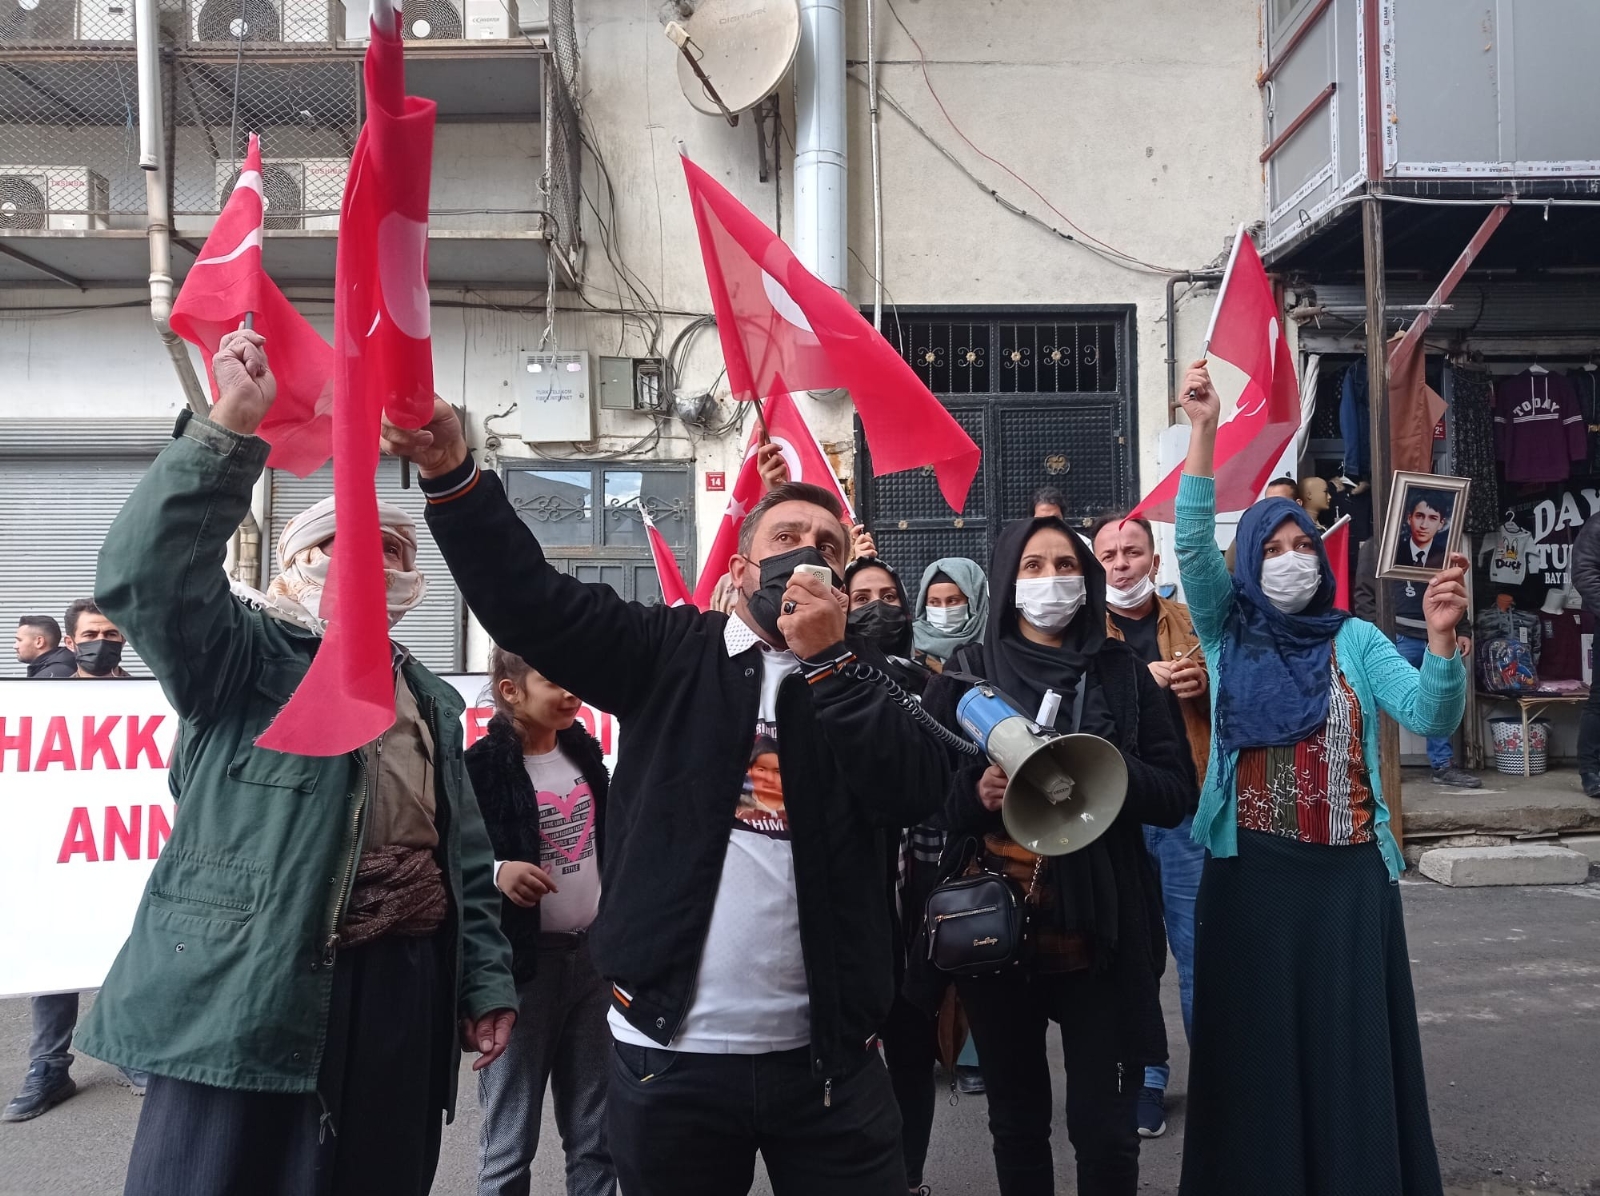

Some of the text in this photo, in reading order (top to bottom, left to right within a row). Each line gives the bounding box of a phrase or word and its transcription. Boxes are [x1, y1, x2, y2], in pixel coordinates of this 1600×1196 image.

[1512, 397, 1560, 417] TODAY
[710, 477, 722, 486] 14
[1545, 572, 1562, 584] BAY
[0, 714, 179, 773] HAKK
